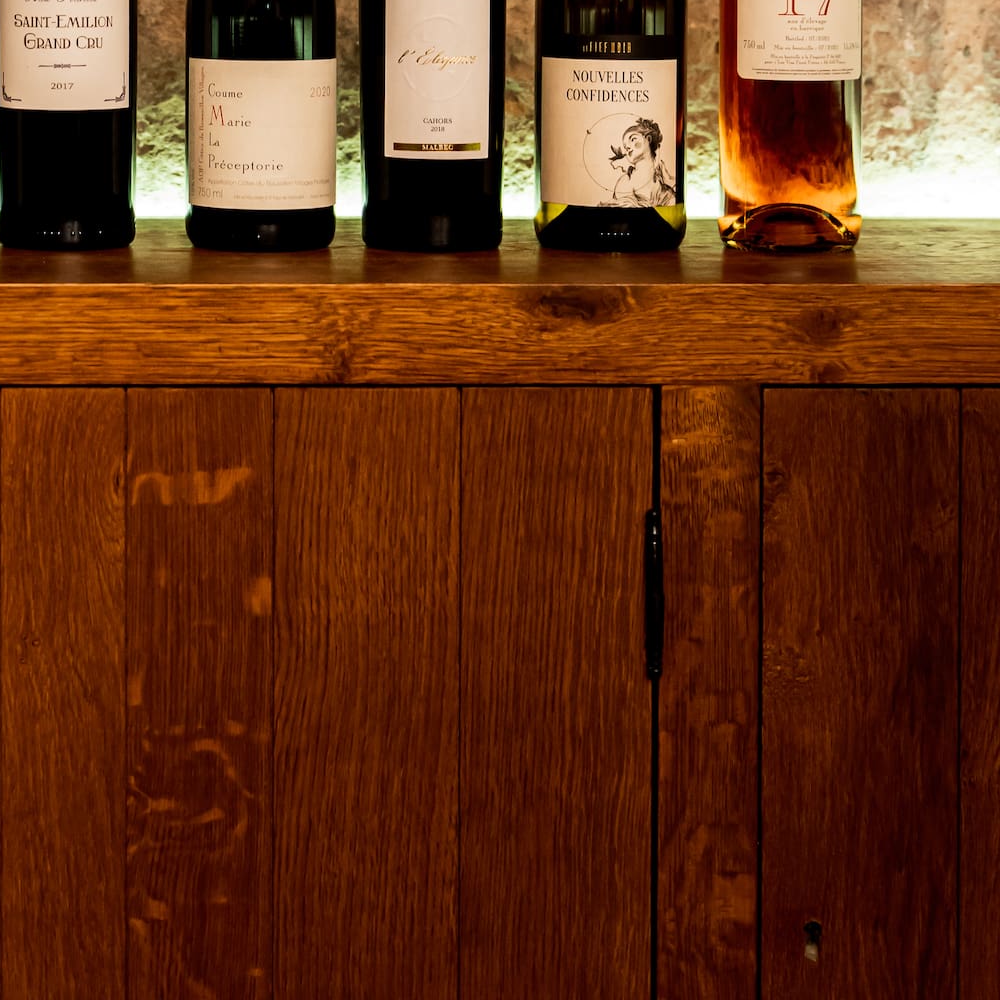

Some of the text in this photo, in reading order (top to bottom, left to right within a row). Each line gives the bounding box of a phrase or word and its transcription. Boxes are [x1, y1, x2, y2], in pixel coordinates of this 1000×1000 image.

[23, 32, 103, 50] GRAND CRU
[572, 69, 644, 84] NOUVELLES
[50, 82, 75, 90] 2017
[208, 82, 243, 98] Coume
[309, 85, 331, 98] 2020
[566, 88, 650, 103] CONFIDENCES
[208, 104, 252, 127] Marie
[208, 131, 220, 147] La
[208, 154, 283, 174] Préceptorie
